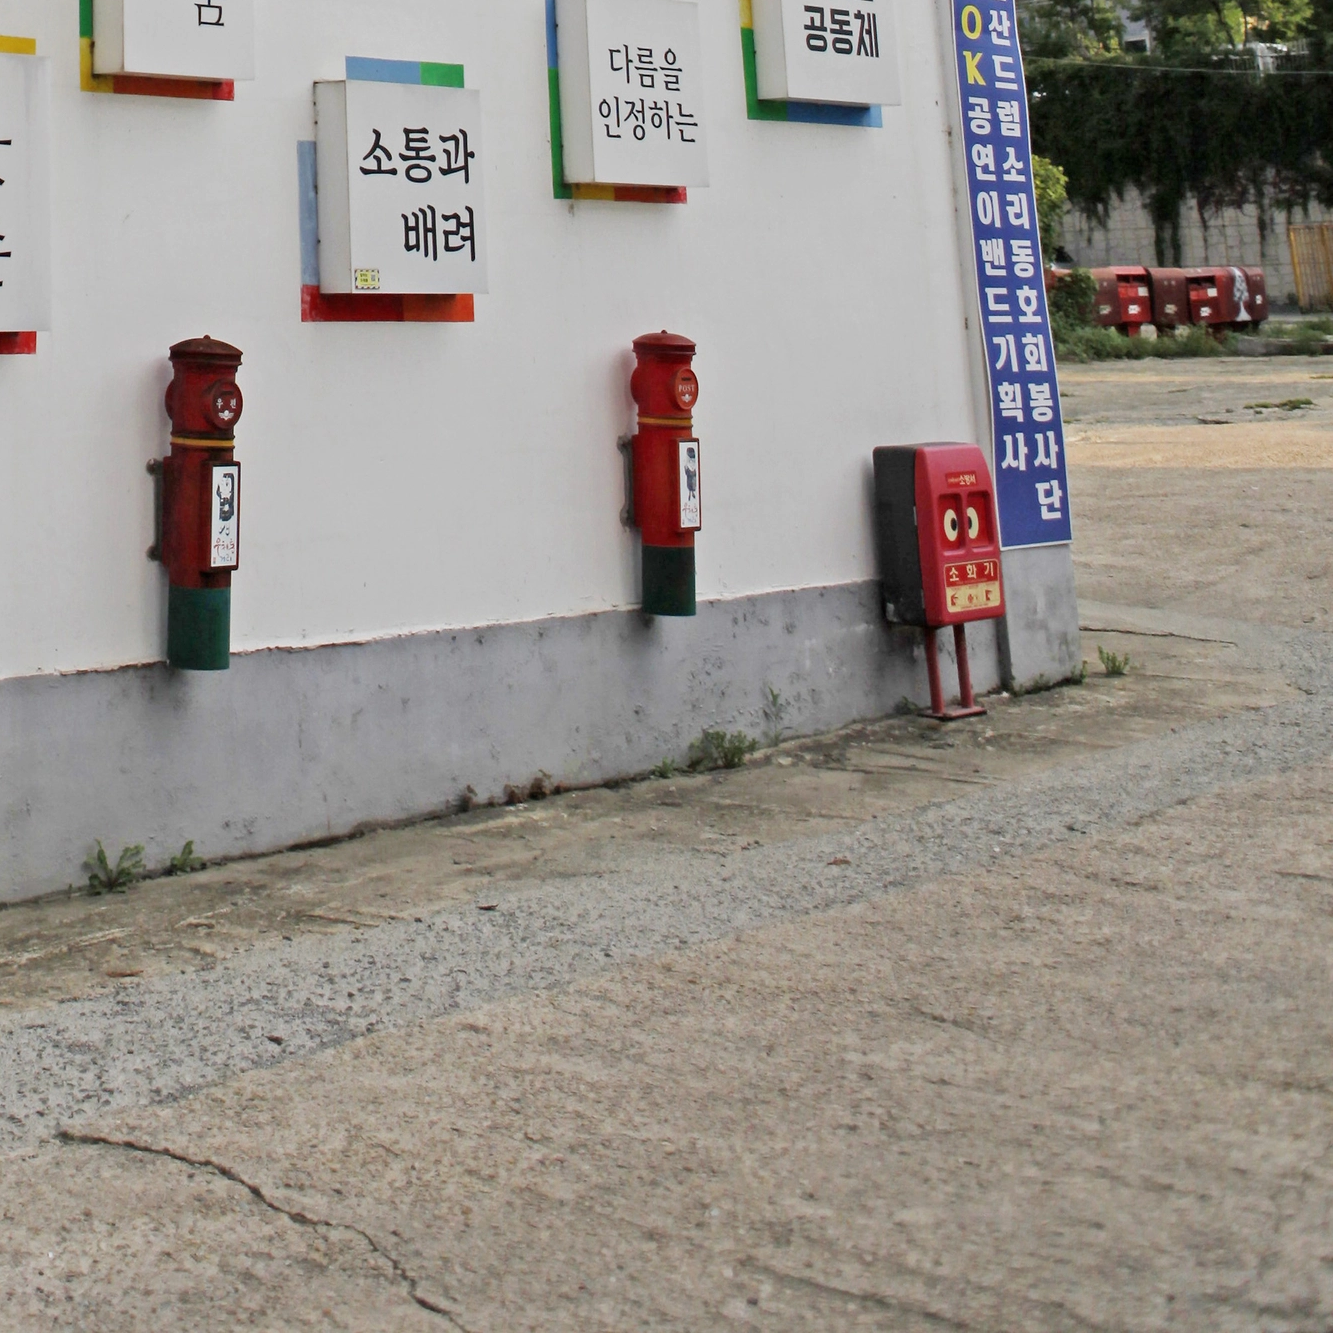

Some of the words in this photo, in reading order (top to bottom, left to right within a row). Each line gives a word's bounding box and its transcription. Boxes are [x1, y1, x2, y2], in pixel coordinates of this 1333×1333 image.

[802, 5, 881, 60] 공동체
[608, 44, 684, 93] 다름을
[597, 96, 699, 144] 인정하는
[359, 126, 476, 185] 소통과
[401, 203, 478, 263] 배려
[949, 562, 994, 582] 소화기
